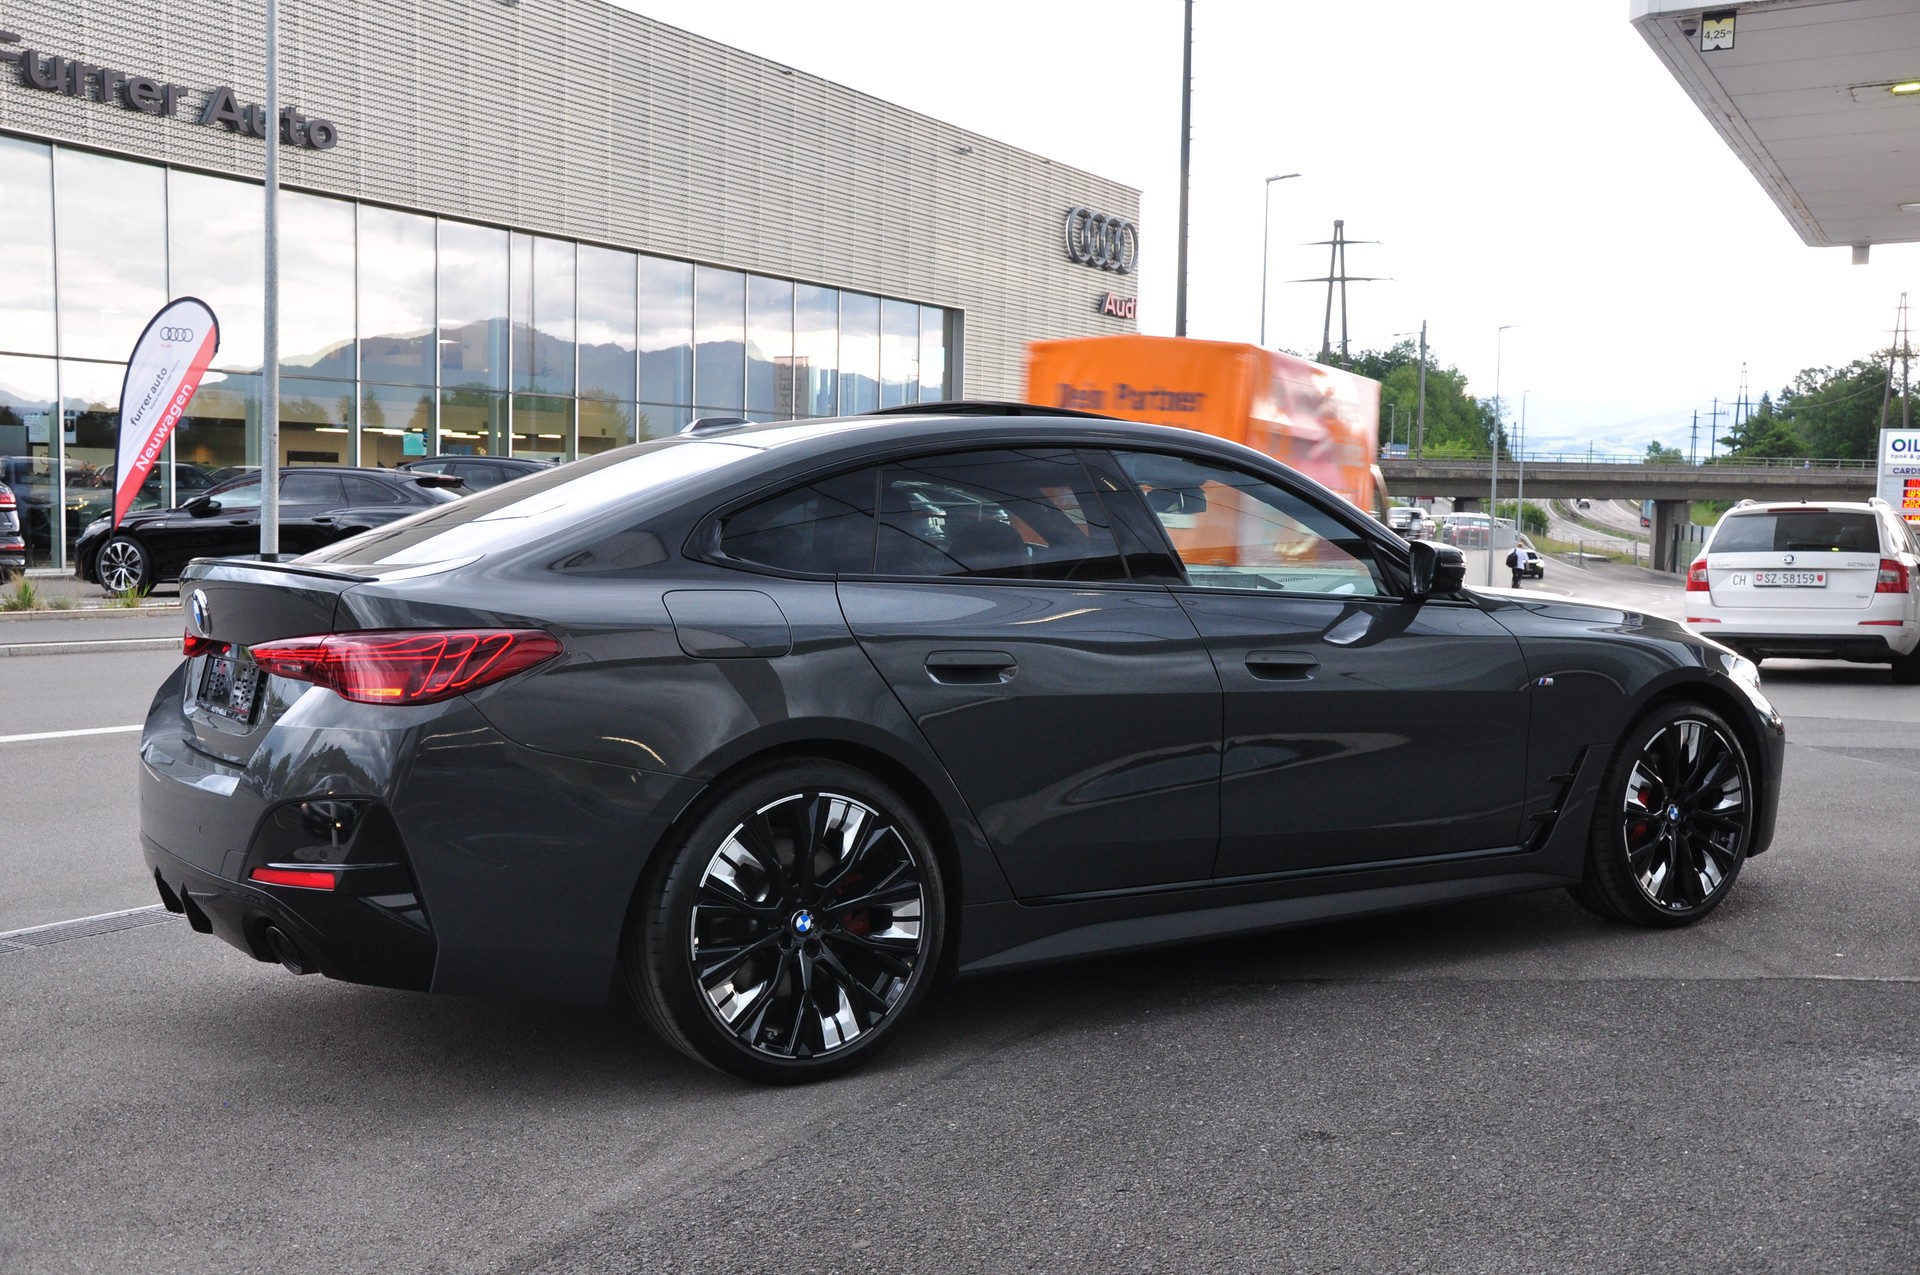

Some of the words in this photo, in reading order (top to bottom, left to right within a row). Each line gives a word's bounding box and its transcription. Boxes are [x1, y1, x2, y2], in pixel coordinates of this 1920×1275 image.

[200, 85, 337, 149] Auto
[130, 392, 152, 426] furrer
[151, 367, 168, 394] auto
[135, 383, 193, 472] Neuwagen
[1732, 574, 1746, 586] CH
